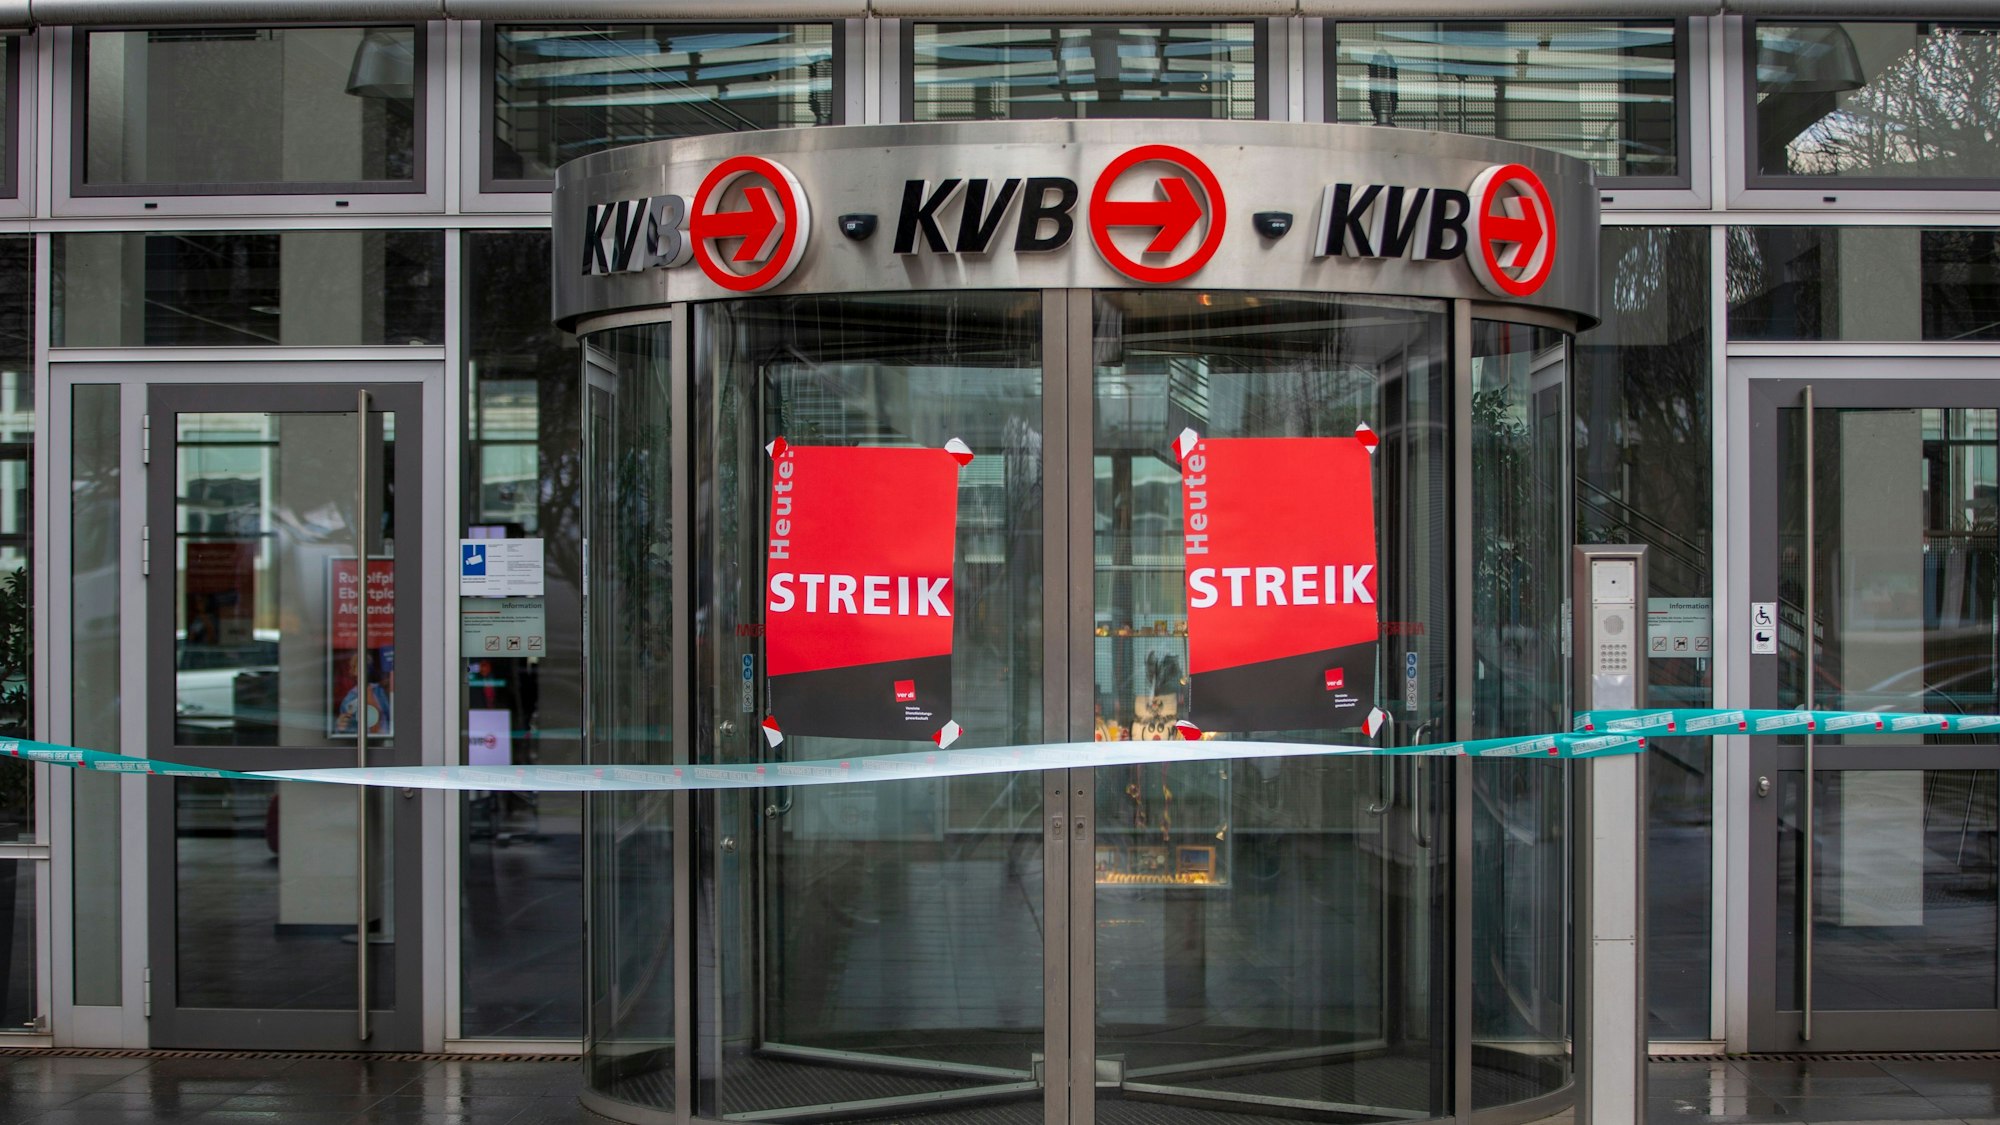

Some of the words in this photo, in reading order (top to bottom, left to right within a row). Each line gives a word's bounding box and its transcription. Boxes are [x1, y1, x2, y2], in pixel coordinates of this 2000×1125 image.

[582, 195, 686, 275] KVB
[893, 177, 1079, 254] KVB
[1322, 183, 1470, 260] KVB
[769, 572, 951, 617] STREIK
[1189, 564, 1375, 609] STREIK
